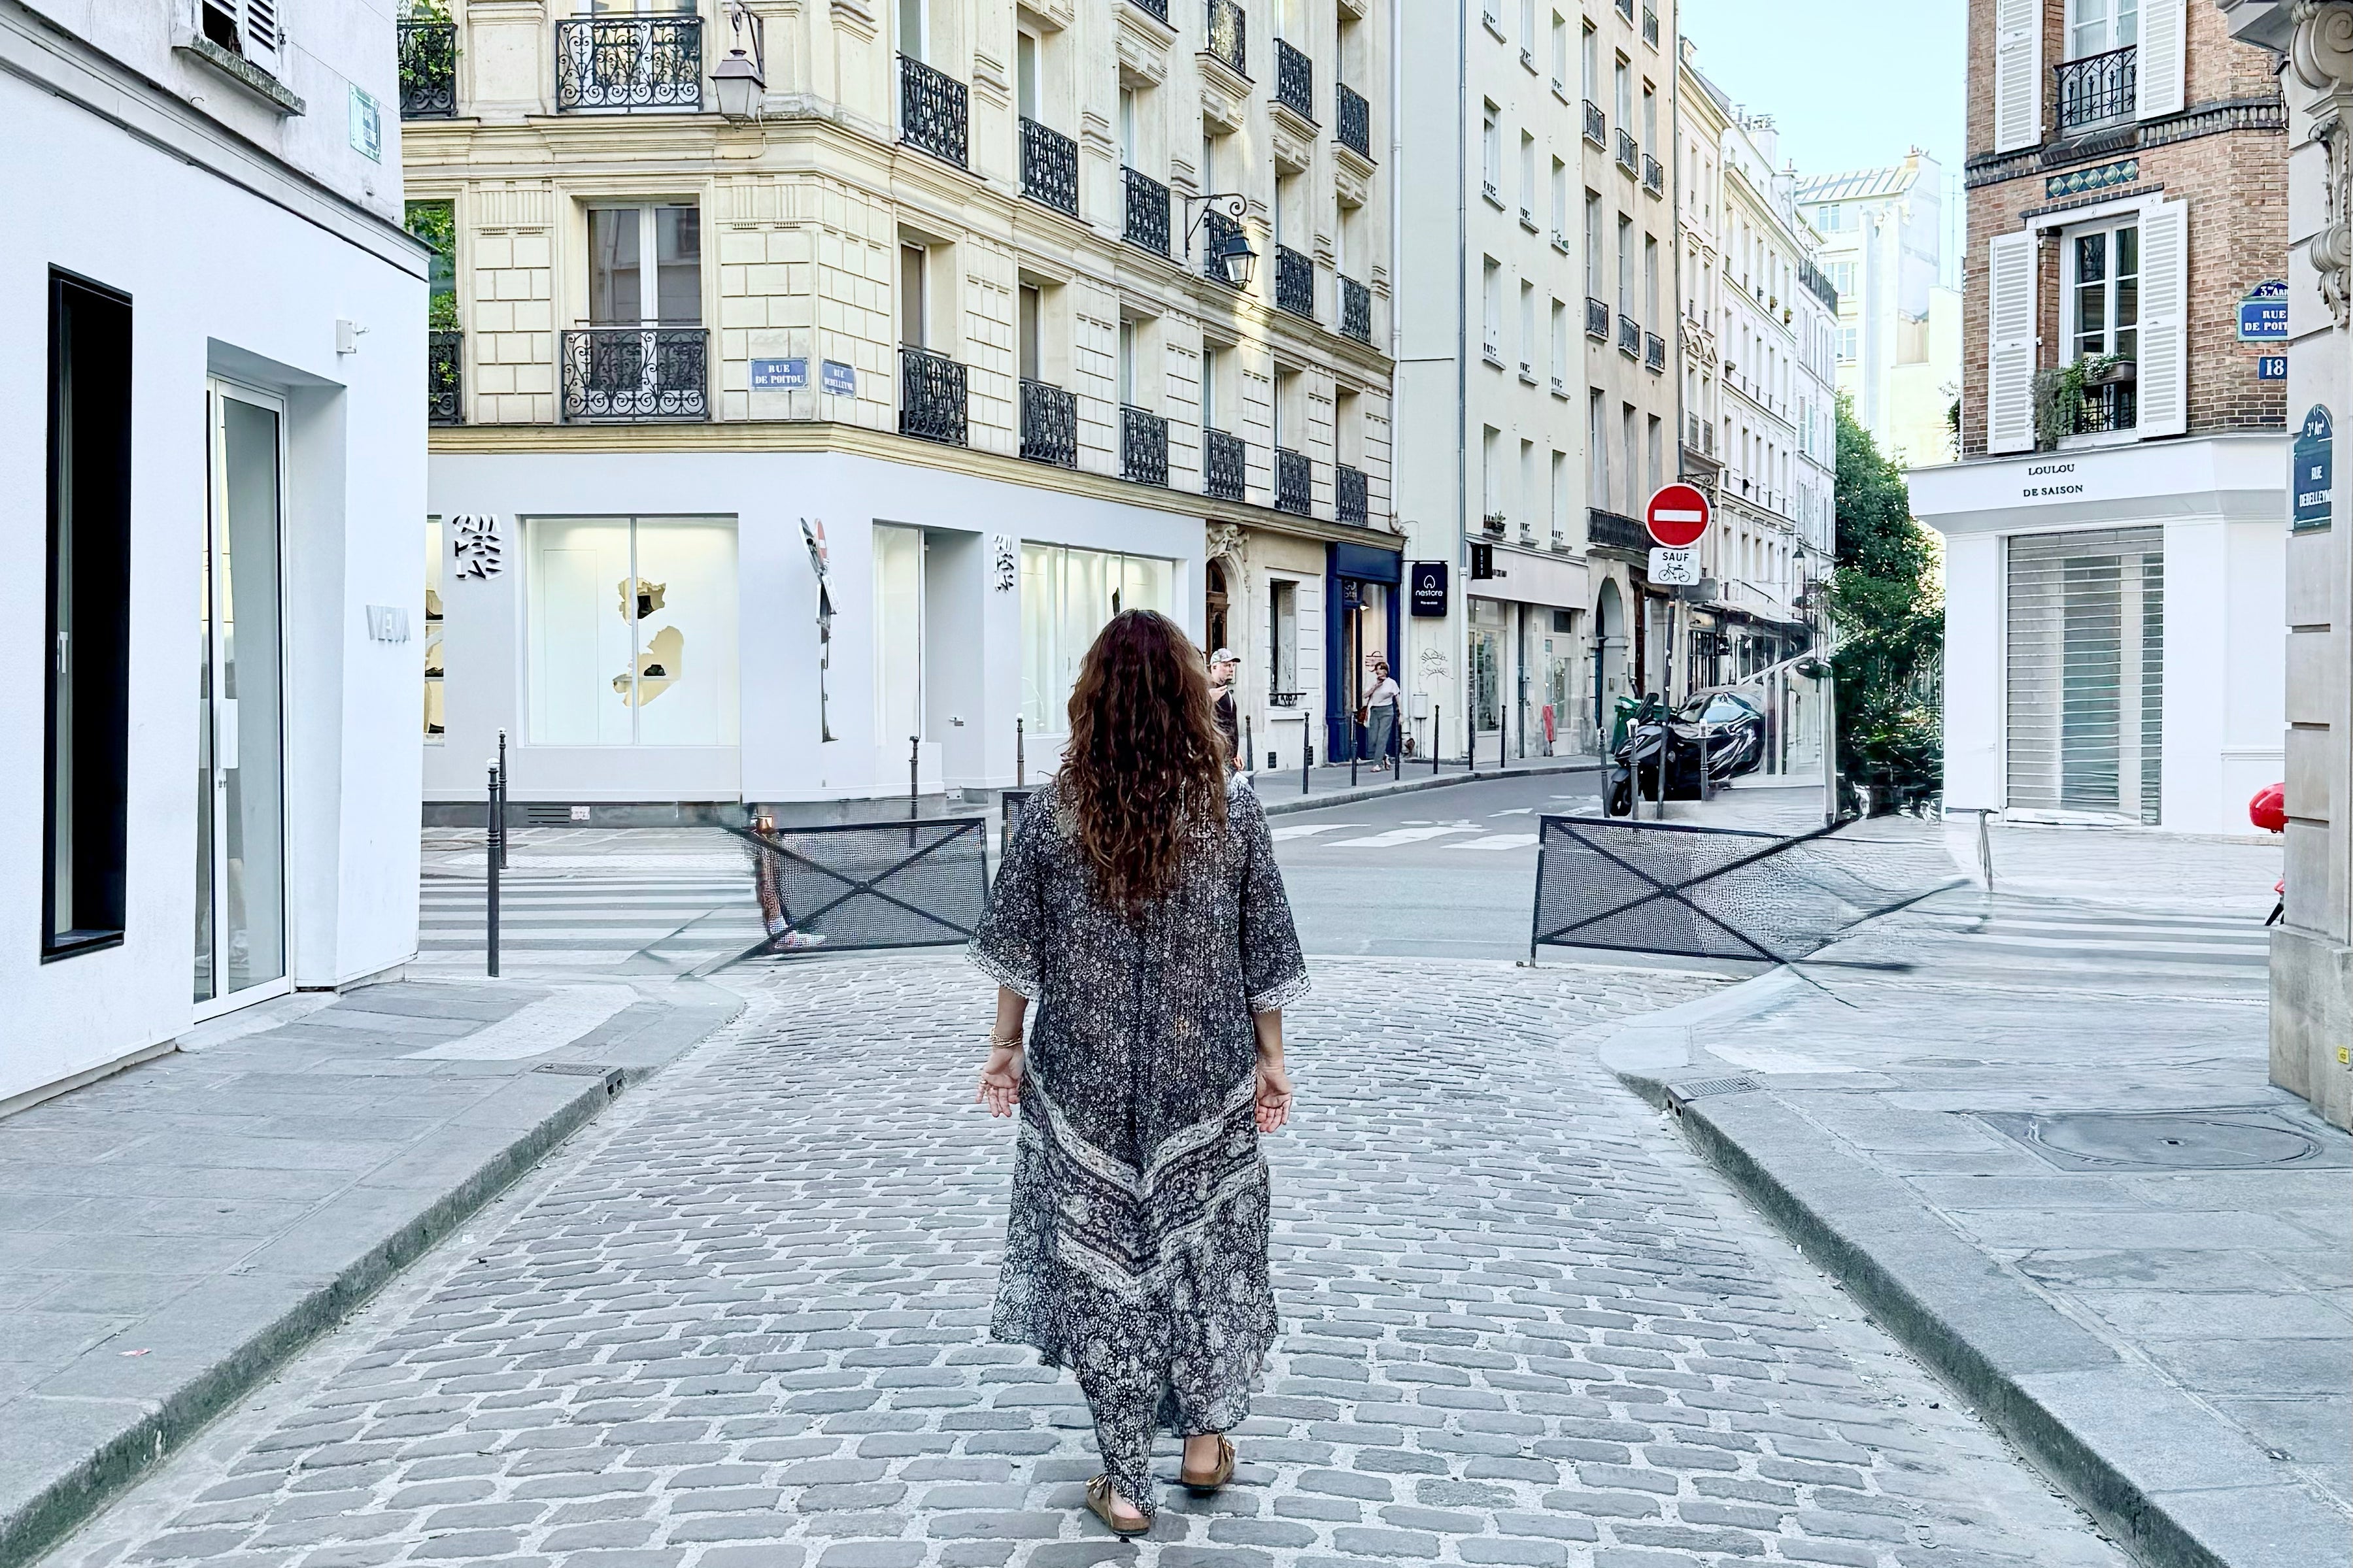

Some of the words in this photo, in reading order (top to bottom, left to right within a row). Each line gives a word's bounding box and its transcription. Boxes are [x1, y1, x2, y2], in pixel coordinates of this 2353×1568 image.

[2262, 310, 2287, 319] RUE
[2244, 322, 2260, 331] DE
[2263, 322, 2288, 331] POIT
[768, 365, 790, 373] RUE
[2266, 359, 2284, 376] 18
[755, 376, 768, 384] DE
[770, 375, 804, 384] POITOU
[2028, 463, 2075, 476] LOULOU
[2311, 465, 2323, 480] RUE
[2023, 488, 2039, 497] DE
[2041, 484, 2083, 495] SAISON
[2299, 488, 2332, 508] DEBELLEYM
[1662, 552, 1690, 562] SAUF
